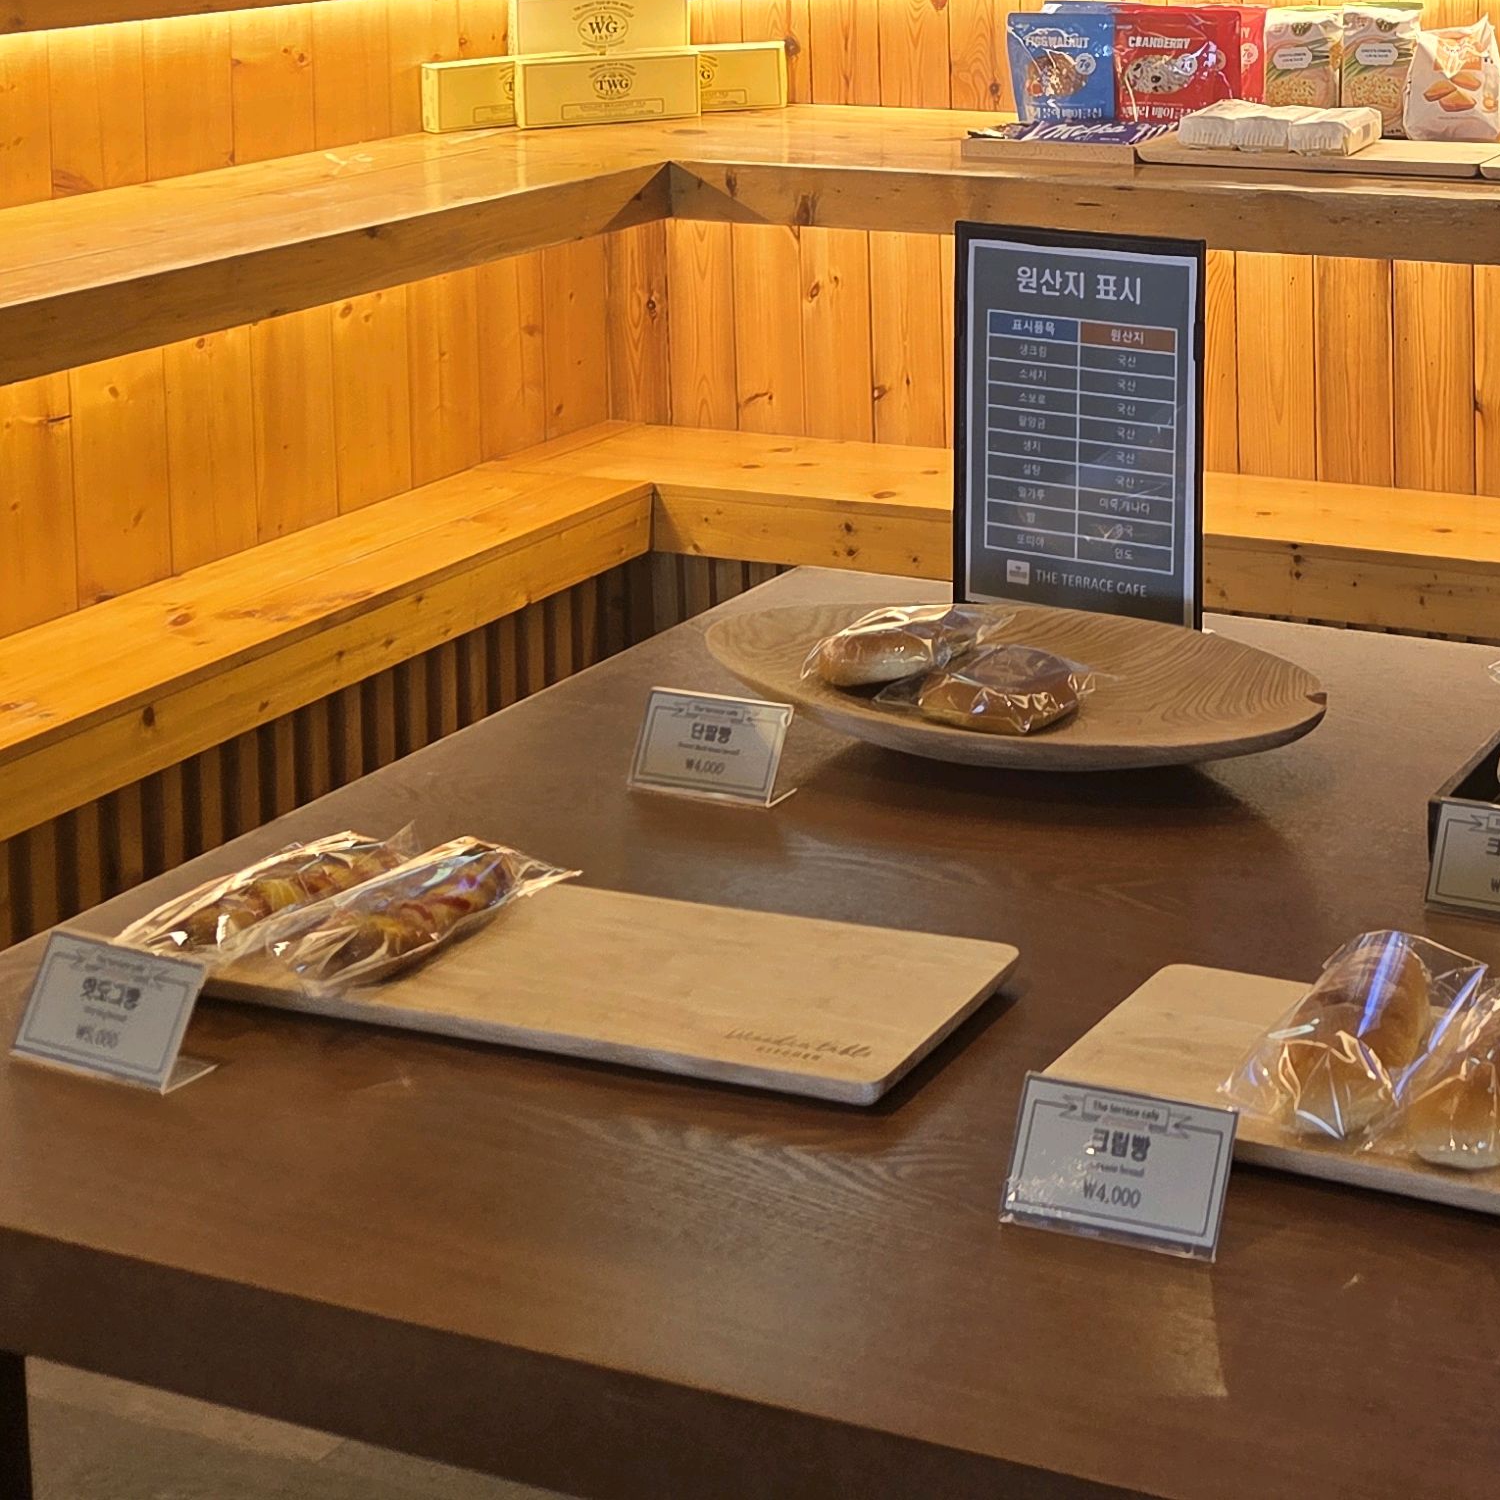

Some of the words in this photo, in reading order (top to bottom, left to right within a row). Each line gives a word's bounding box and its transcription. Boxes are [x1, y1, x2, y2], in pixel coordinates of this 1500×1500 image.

[1128, 36, 1191, 49] CRANBERRY
[596, 79, 629, 91] TWG
[1042, 123, 1128, 140] Milka
[1017, 266, 1085, 299] 원산지
[1096, 274, 1141, 305] 표시
[1012, 319, 1055, 336] 표시품목
[1111, 329, 1144, 344] 원산지
[1036, 569, 1057, 584] THE
[1061, 573, 1113, 593] TERRACE
[1116, 582, 1147, 597] CAFE
